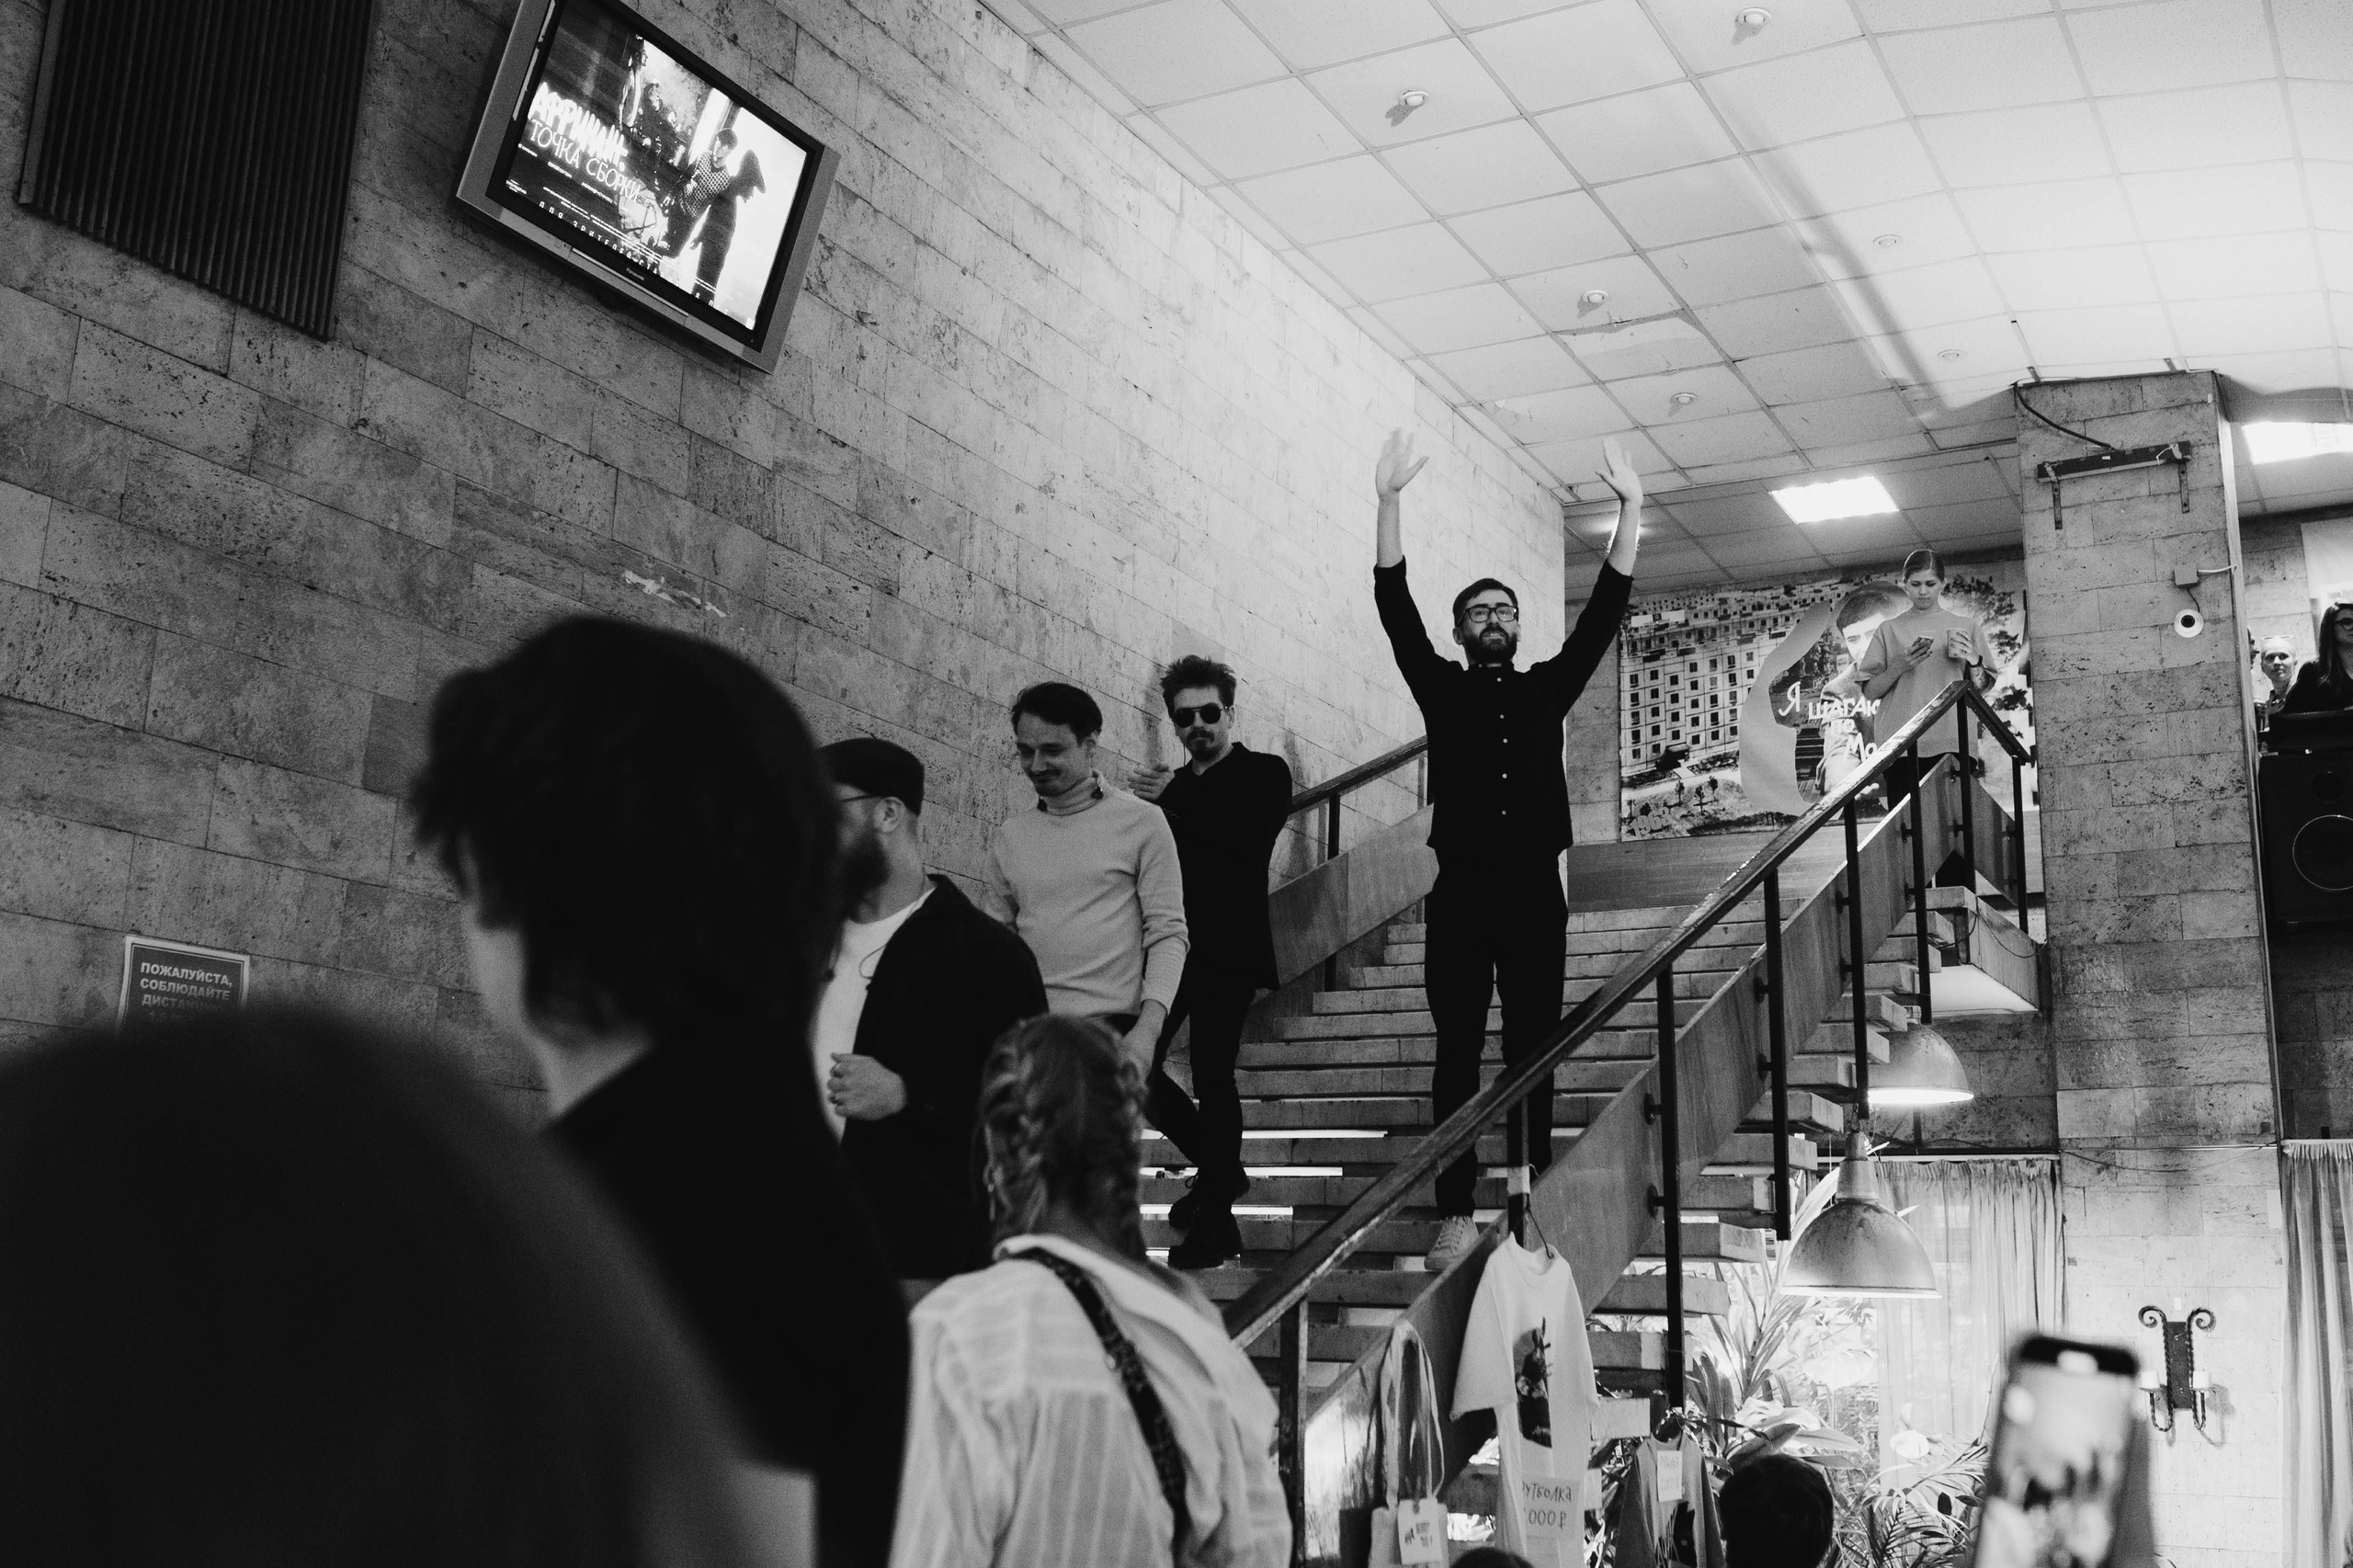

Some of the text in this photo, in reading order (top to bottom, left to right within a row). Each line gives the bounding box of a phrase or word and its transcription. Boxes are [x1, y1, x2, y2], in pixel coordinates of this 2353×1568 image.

[530, 119, 581, 169] ТОЧКА
[586, 158, 641, 203] СБОРКИ
[1779, 681, 1801, 716] Я
[140, 978, 231, 1001] СОБЛЮДАЙТЕ
[141, 962, 233, 987] ПОЖАЛУЙСТА,
